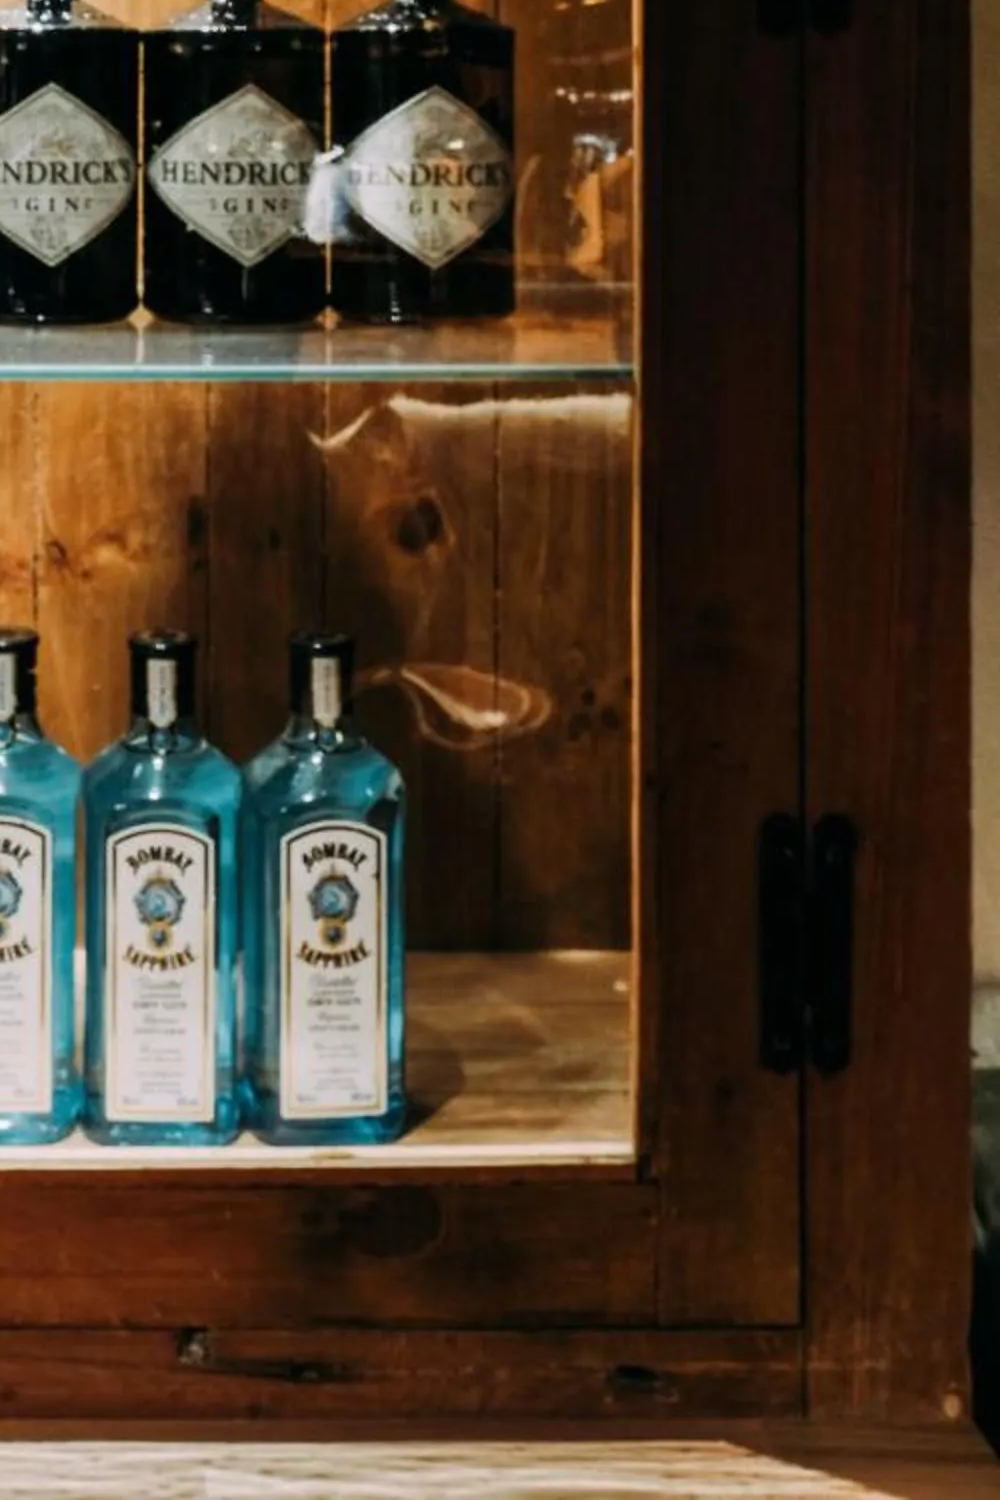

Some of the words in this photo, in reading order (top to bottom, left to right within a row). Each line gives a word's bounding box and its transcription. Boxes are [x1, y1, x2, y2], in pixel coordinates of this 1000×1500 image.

[162, 160, 313, 186] HENDRICK
[25, 197, 79, 213] GIN
[224, 197, 281, 214] GIN
[409, 200, 461, 216] GIN
[125, 846, 194, 875] BOMBAY
[302, 843, 368, 873] BOMBAY
[122, 944, 196, 971] SAPPHIRE
[298, 941, 370, 968] SAPPHIRE
